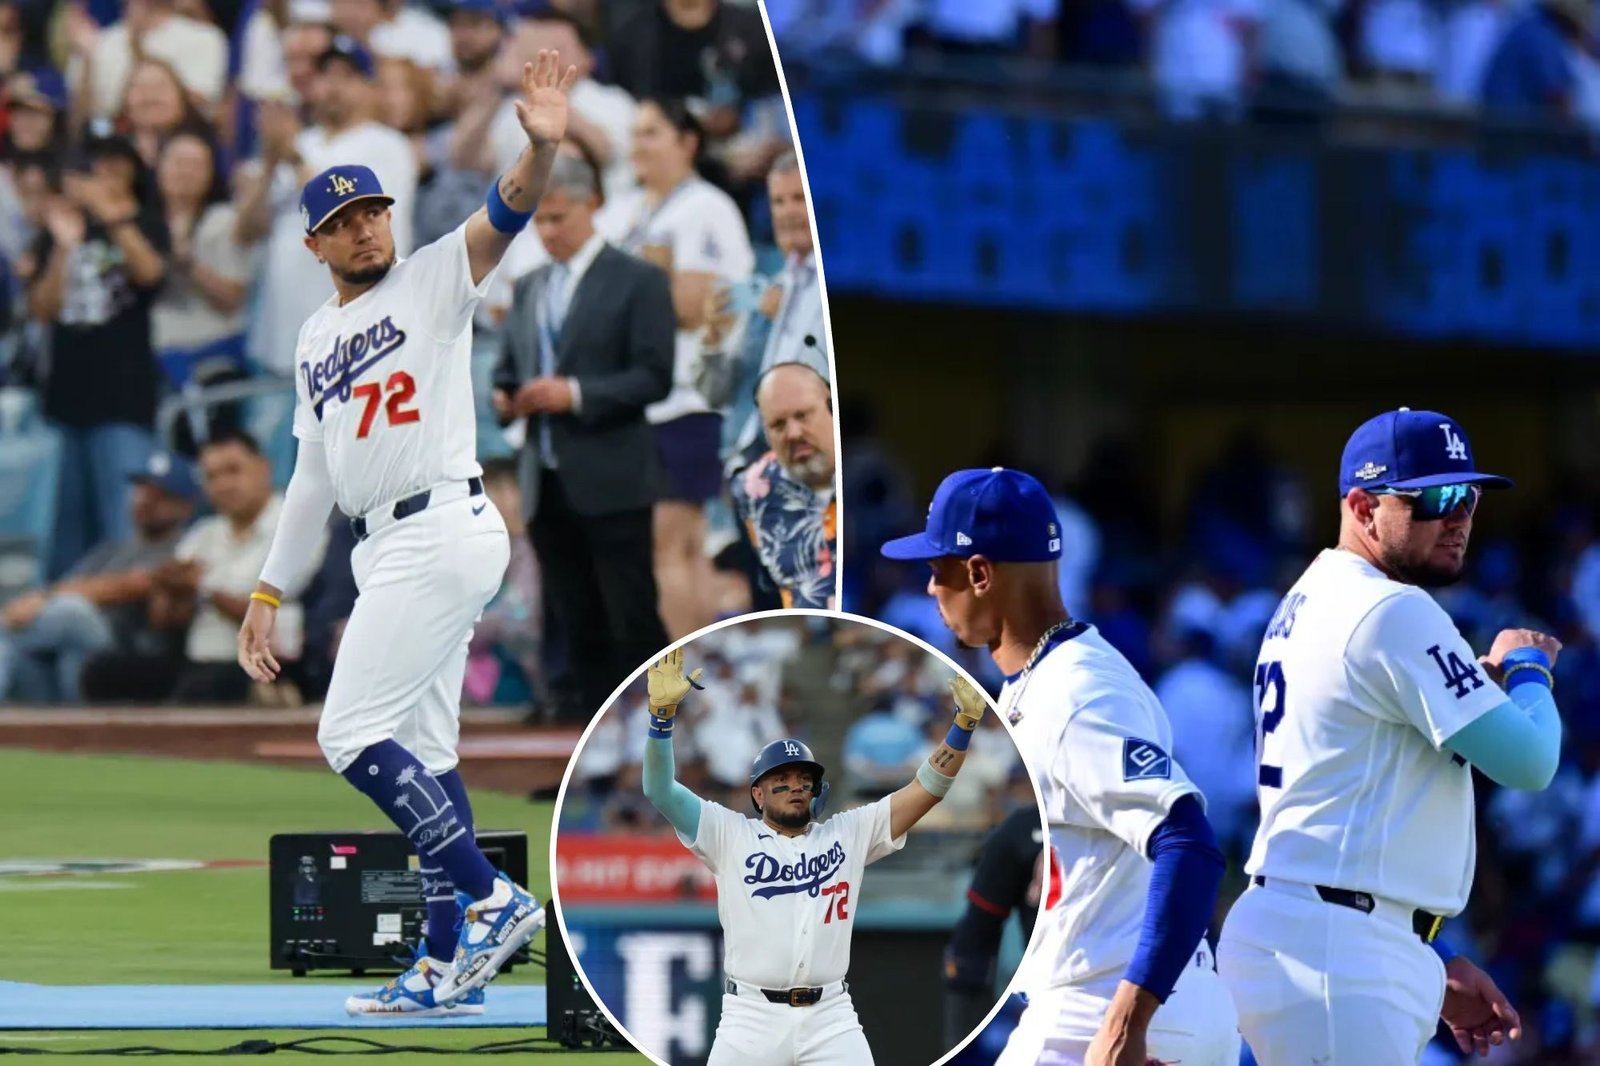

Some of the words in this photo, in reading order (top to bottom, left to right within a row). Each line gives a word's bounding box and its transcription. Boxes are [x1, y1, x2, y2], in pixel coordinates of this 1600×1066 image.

[328, 174, 356, 196] LA
[352, 370, 421, 440] 72
[1439, 423, 1468, 461] LA
[1426, 644, 1485, 700] LA
[783, 740, 800, 757] LA
[743, 840, 847, 900] Dodgers
[821, 881, 850, 924] 72
